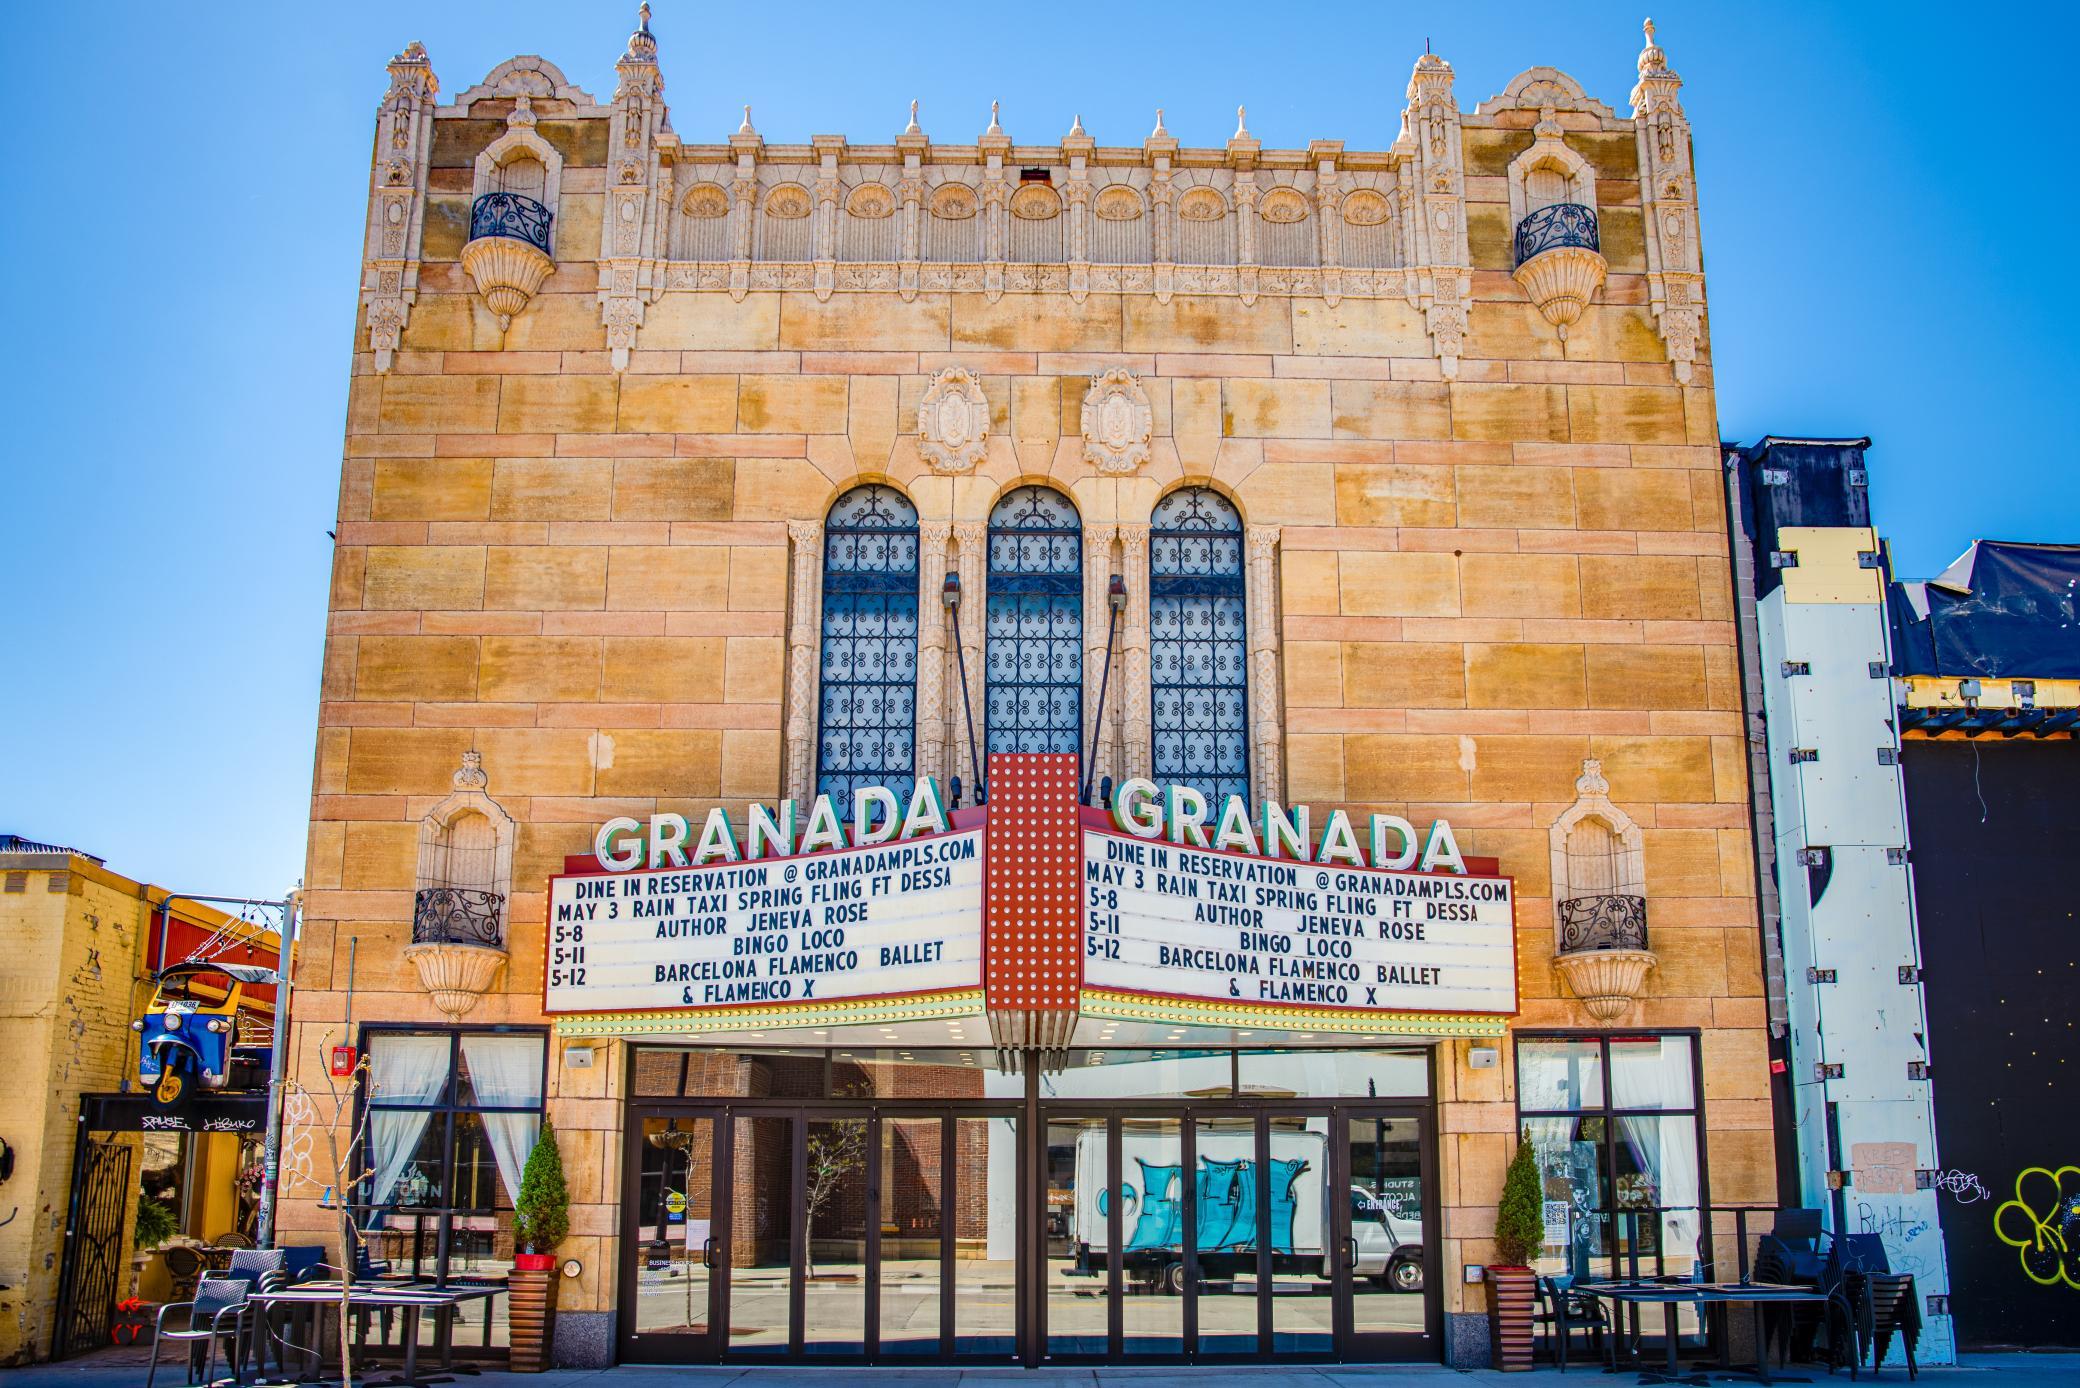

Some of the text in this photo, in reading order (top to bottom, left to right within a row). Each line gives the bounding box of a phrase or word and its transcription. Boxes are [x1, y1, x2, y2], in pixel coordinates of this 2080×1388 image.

[595, 775, 951, 872] GRANADA
[1112, 777, 1468, 875] GRANADA
[575, 838, 975, 900] DINE IN RESERVATION @ GRANADAMPLS.COM
[1087, 860, 1478, 922] MAY 3 RAIN TAXI SPRING FLING FT DESSA
[1107, 839, 1507, 902] DINE IN RESERVATION @ GRANADAMPLS.COM
[558, 866, 951, 922] MAY 3 RAIN TAXI SPRING FLING FT DESSA
[1090, 889, 1425, 941] 5-8 AUTHOR JENEVA ROSE
[554, 928, 845, 965] 5-11 BINGO LOCO
[555, 901, 868, 944] 5-8 AUTHOR JENEVA ROSE
[1089, 913, 1352, 959] 5-11 BINGO LOCO
[551, 940, 944, 987] 5-12 BARCELONA FLAMENCO BALLET
[1087, 937, 1441, 986] 5-12 BARCELONA FLAMENCO BALLET
[682, 978, 816, 1003] & FLAMENCO X
[1229, 977, 1377, 1005] & FLAMENCO X
[358, 1182, 443, 1198] UTOWN
[1366, 1199, 1400, 1210] ENTRANCE
